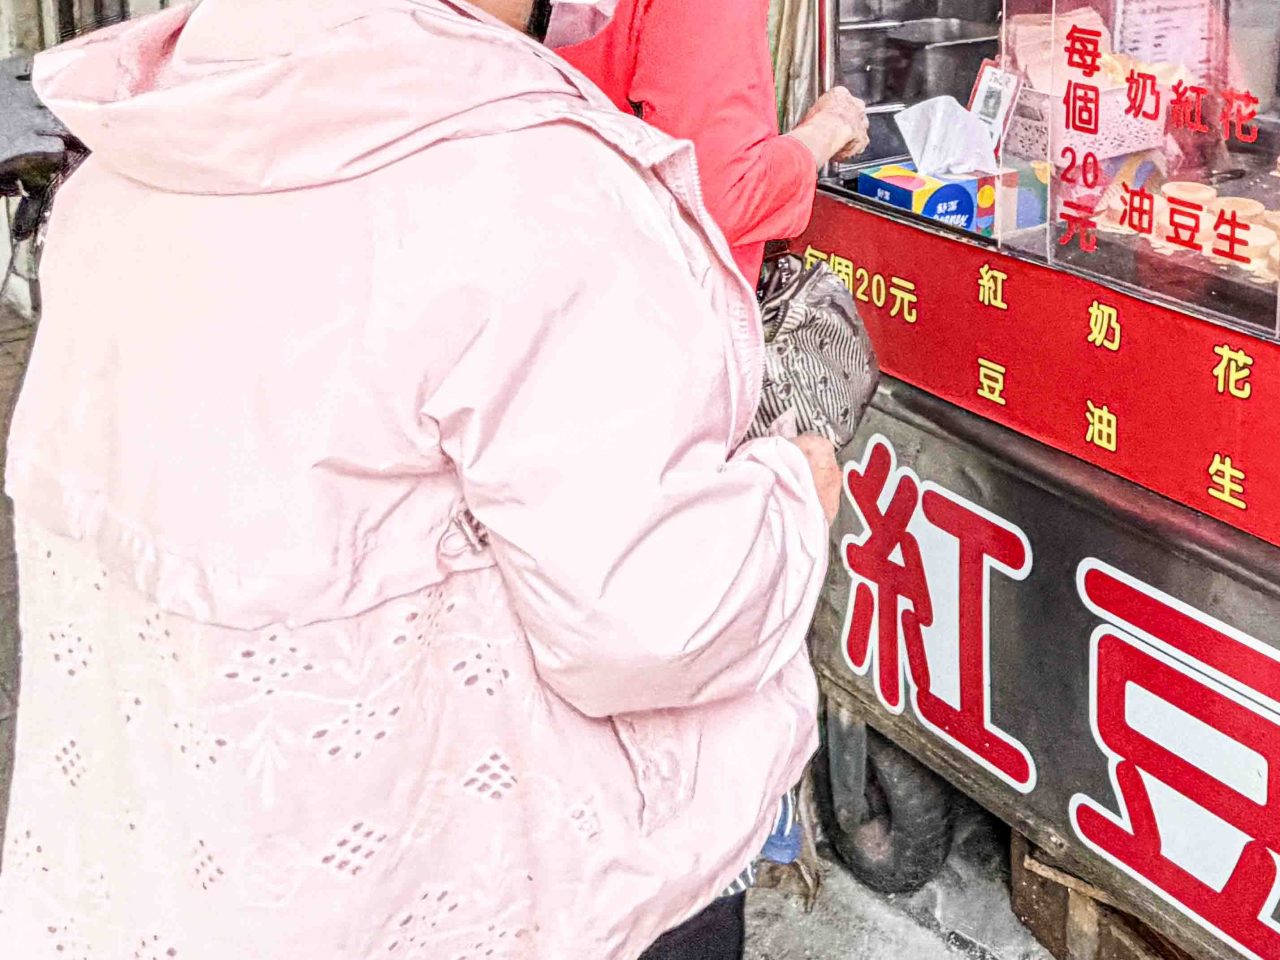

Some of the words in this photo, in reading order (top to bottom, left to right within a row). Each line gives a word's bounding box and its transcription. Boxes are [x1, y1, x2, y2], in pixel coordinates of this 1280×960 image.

[1059, 24, 1101, 253] 每個20元
[1119, 69, 1160, 235] 奶油
[1166, 79, 1209, 252] 紅豆
[1212, 87, 1258, 264] 花生
[976, 264, 1008, 405] 紅豆
[1085, 300, 1122, 452] 奶油
[1207, 344, 1254, 510] 花生
